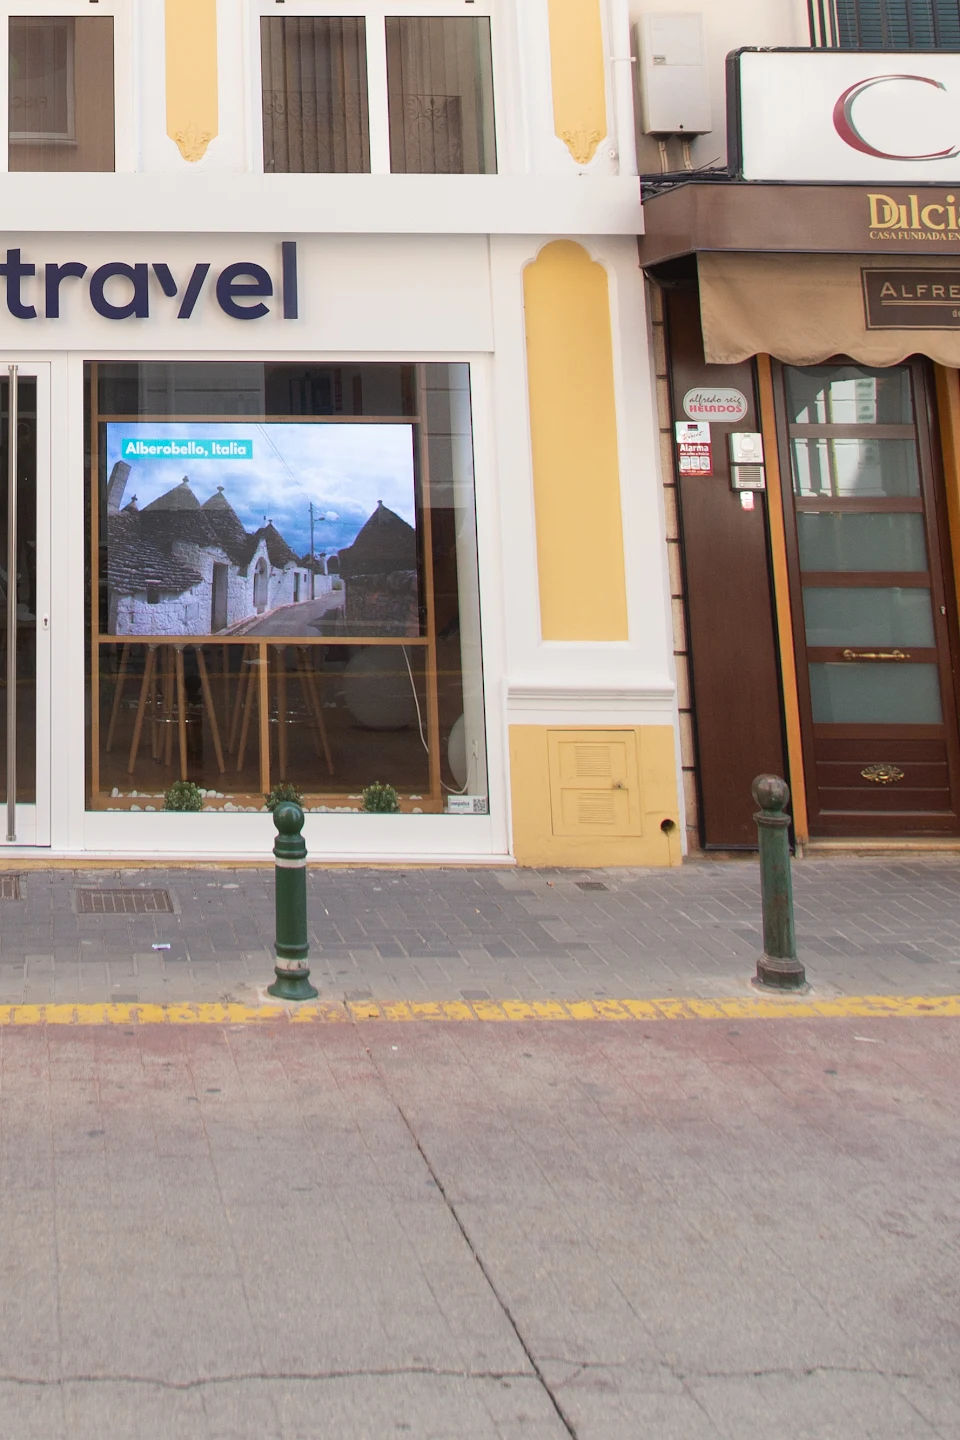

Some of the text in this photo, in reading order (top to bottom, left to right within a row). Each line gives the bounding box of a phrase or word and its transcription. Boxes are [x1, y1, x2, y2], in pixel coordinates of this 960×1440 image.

[867, 194, 960, 230] Dulci
[869, 231, 899, 240] CASA
[898, 231, 947, 241] FUNDADA
[689, 394, 722, 406] alfredo
[689, 405, 742, 413] HELADOS
[125, 441, 247, 457] Alberobello, Italia
[680, 443, 709, 452] Alarma
